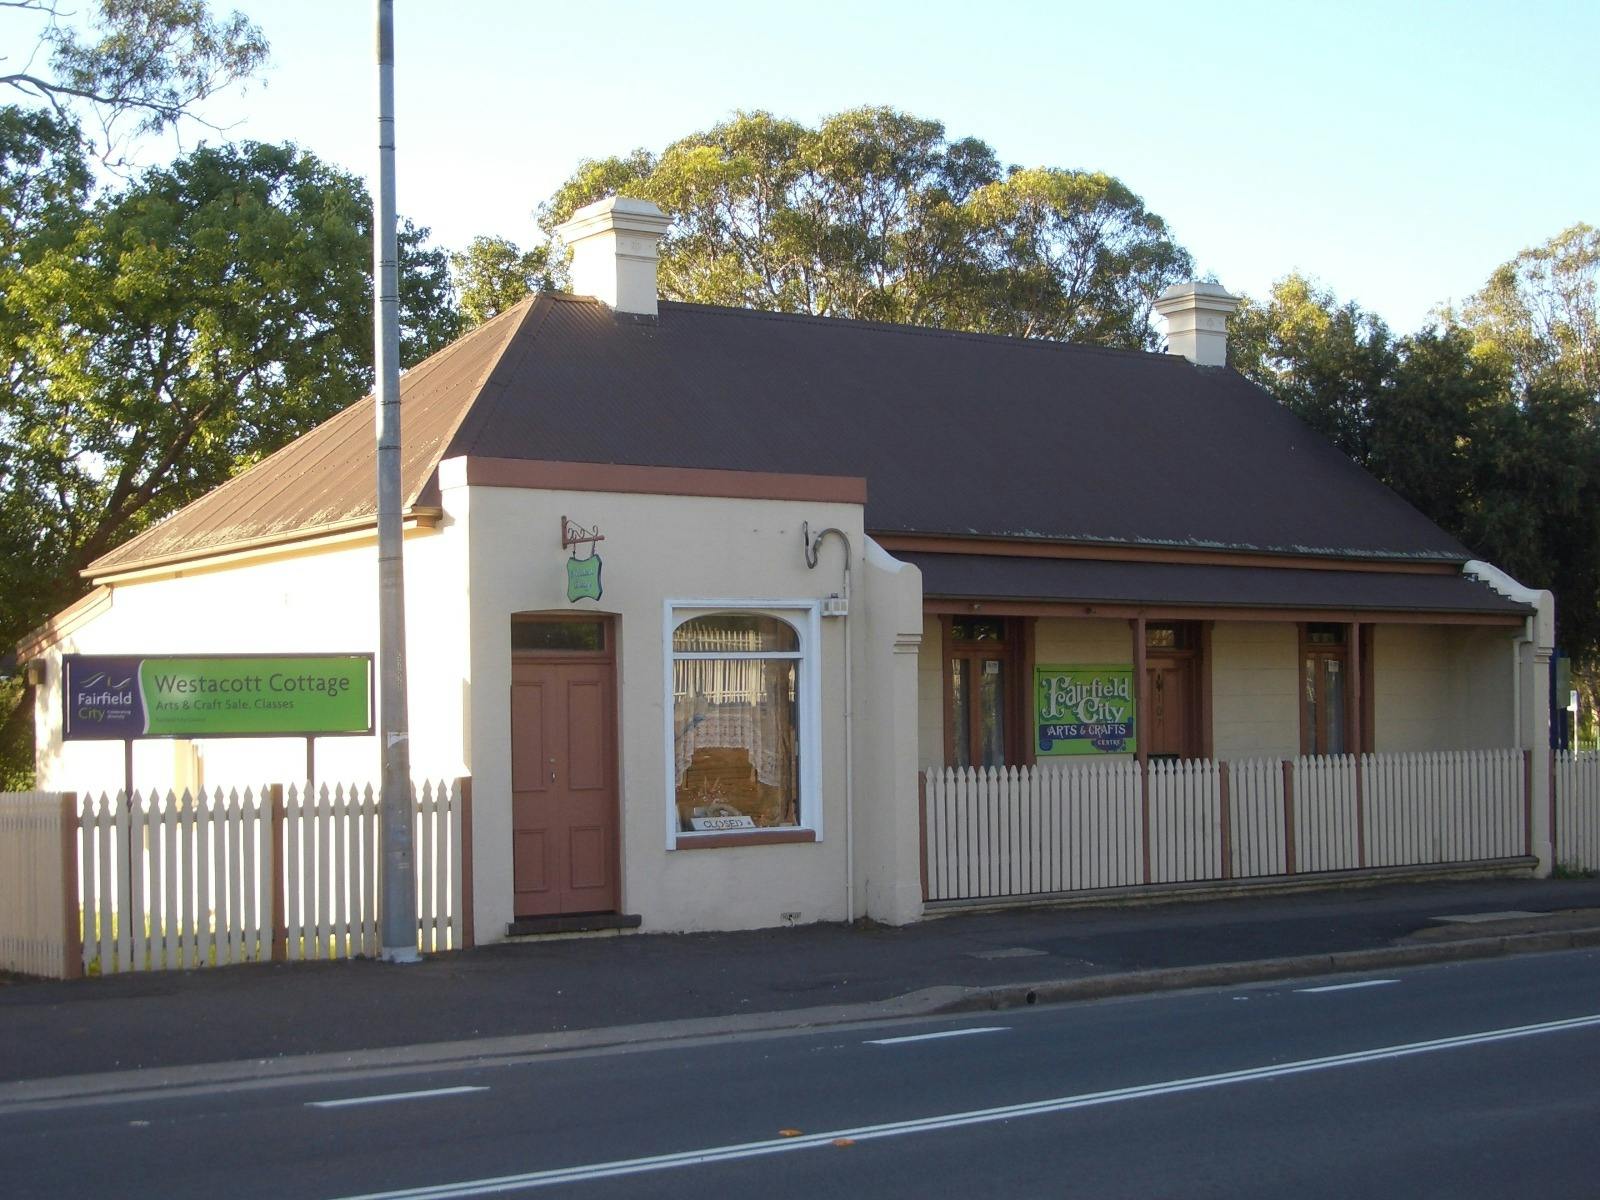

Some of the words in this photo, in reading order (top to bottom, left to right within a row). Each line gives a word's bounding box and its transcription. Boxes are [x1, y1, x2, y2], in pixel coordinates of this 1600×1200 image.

[154, 674, 262, 693] Westacott
[269, 673, 350, 697] Cottage
[78, 691, 132, 705] Fairfield
[156, 700, 179, 711] Arts
[182, 700, 190, 711] &
[193, 699, 221, 710] Craft
[254, 699, 294, 709] Classes
[1041, 676, 1130, 718] Fairfield
[78, 707, 106, 723] City
[1073, 697, 1124, 724] City
[1047, 723, 1077, 738] ARTS
[1088, 722, 1126, 738] CRAFTS
[703, 819, 743, 828] CLOSED
